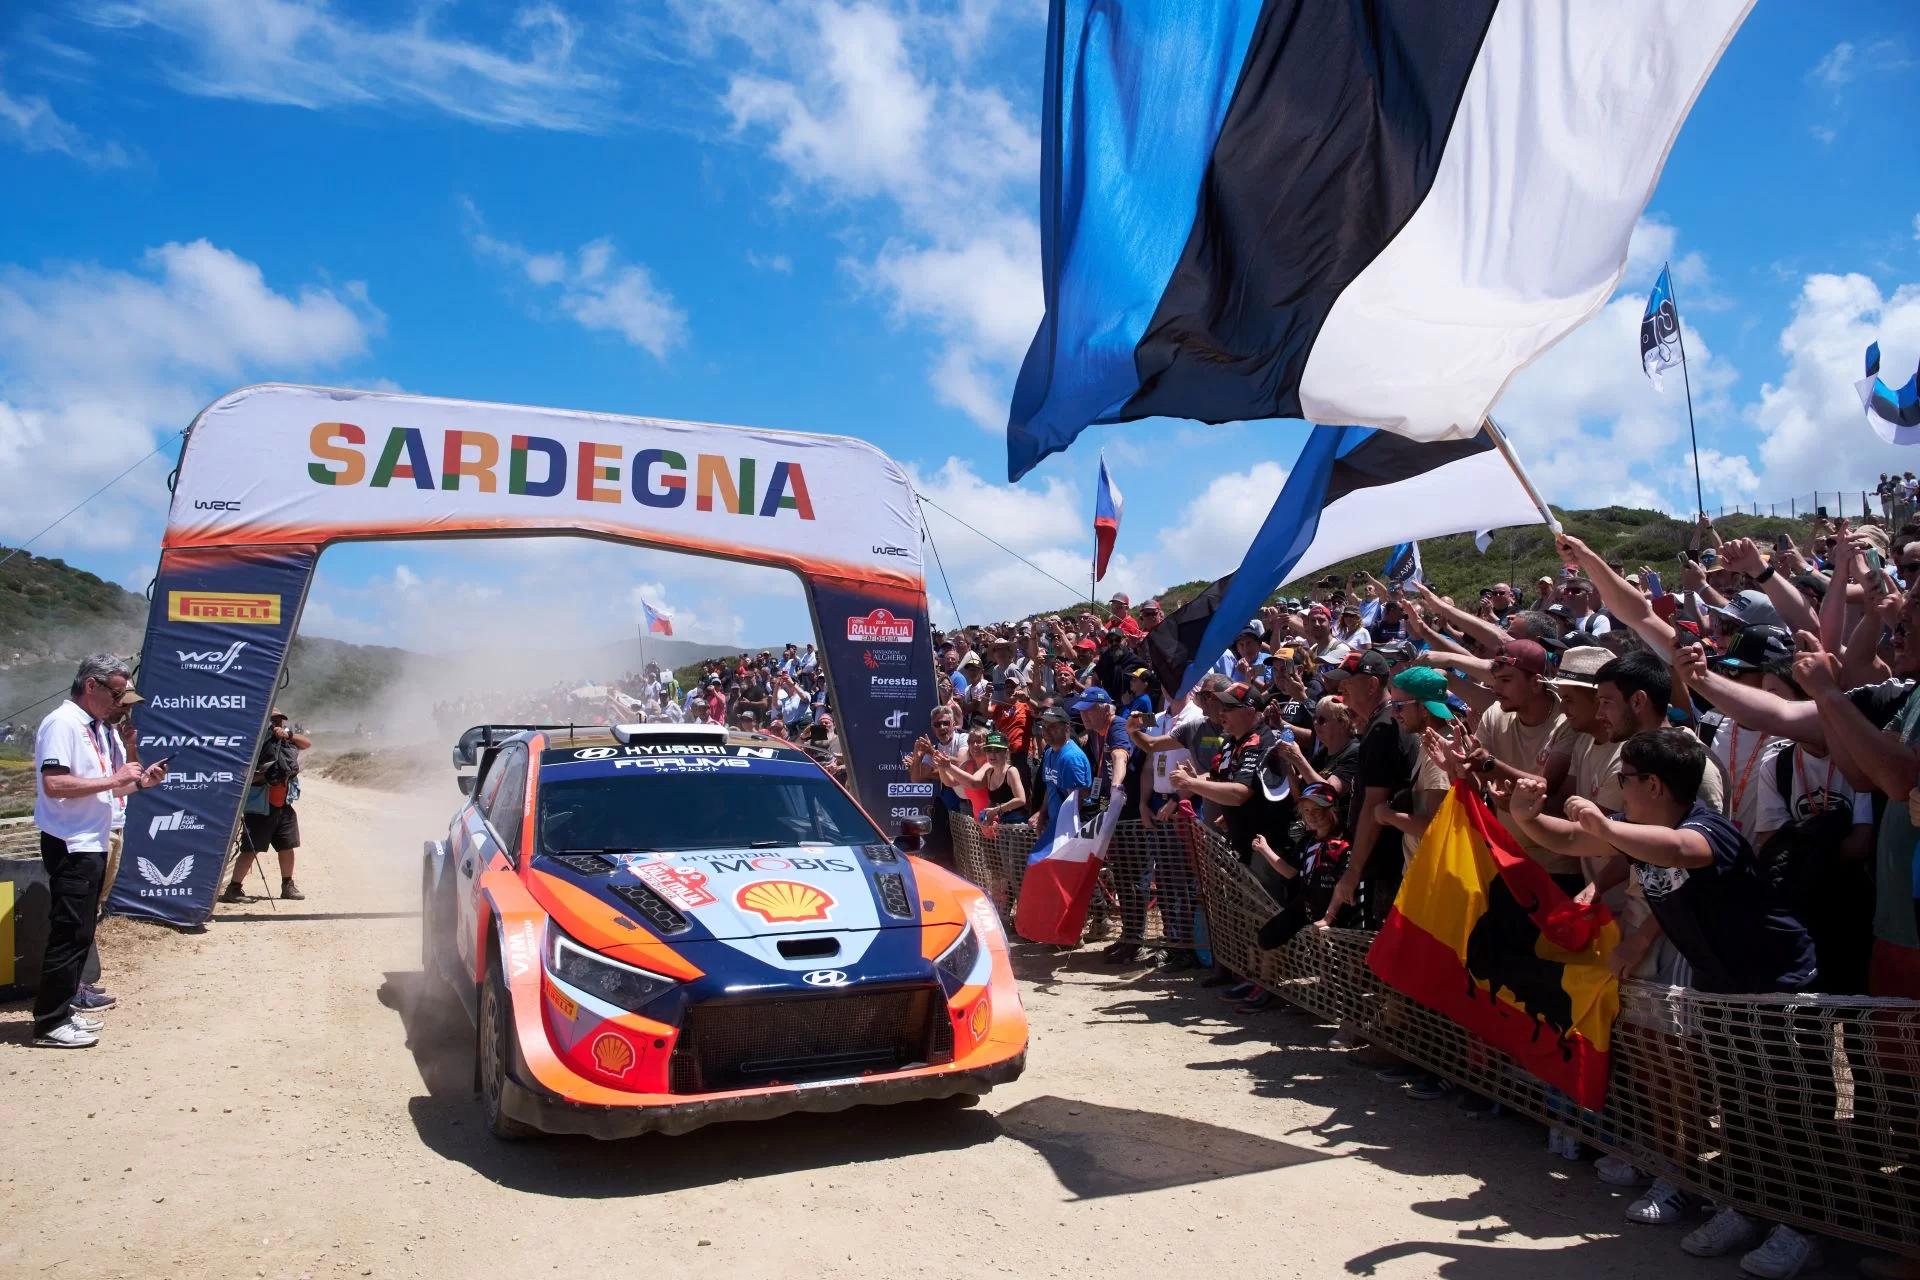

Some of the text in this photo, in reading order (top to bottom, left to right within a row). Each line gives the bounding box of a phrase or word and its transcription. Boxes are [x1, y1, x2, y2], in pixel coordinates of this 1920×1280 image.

[306, 421, 816, 521] SARDEGNA
[195, 500, 241, 511] WRC
[872, 546, 909, 557] WRC
[180, 597, 272, 618] PIRELLI
[852, 624, 909, 636] RALLY ITALIA
[871, 676, 918, 686] Forestas
[151, 695, 246, 709] AsahiKASEI
[885, 709, 909, 728] dr
[139, 735, 244, 747] FANATEC
[624, 745, 774, 758] HYUNDAI N
[614, 758, 750, 769] FORUM8
[160, 772, 234, 783] RUM8
[889, 784, 932, 795] sparco
[891, 807, 919, 817] sara
[680, 852, 781, 862] HYUNDAI
[710, 857, 855, 874] MOBIS
[140, 888, 193, 897] CASTORE
[546, 981, 574, 1016] PIRELLI
